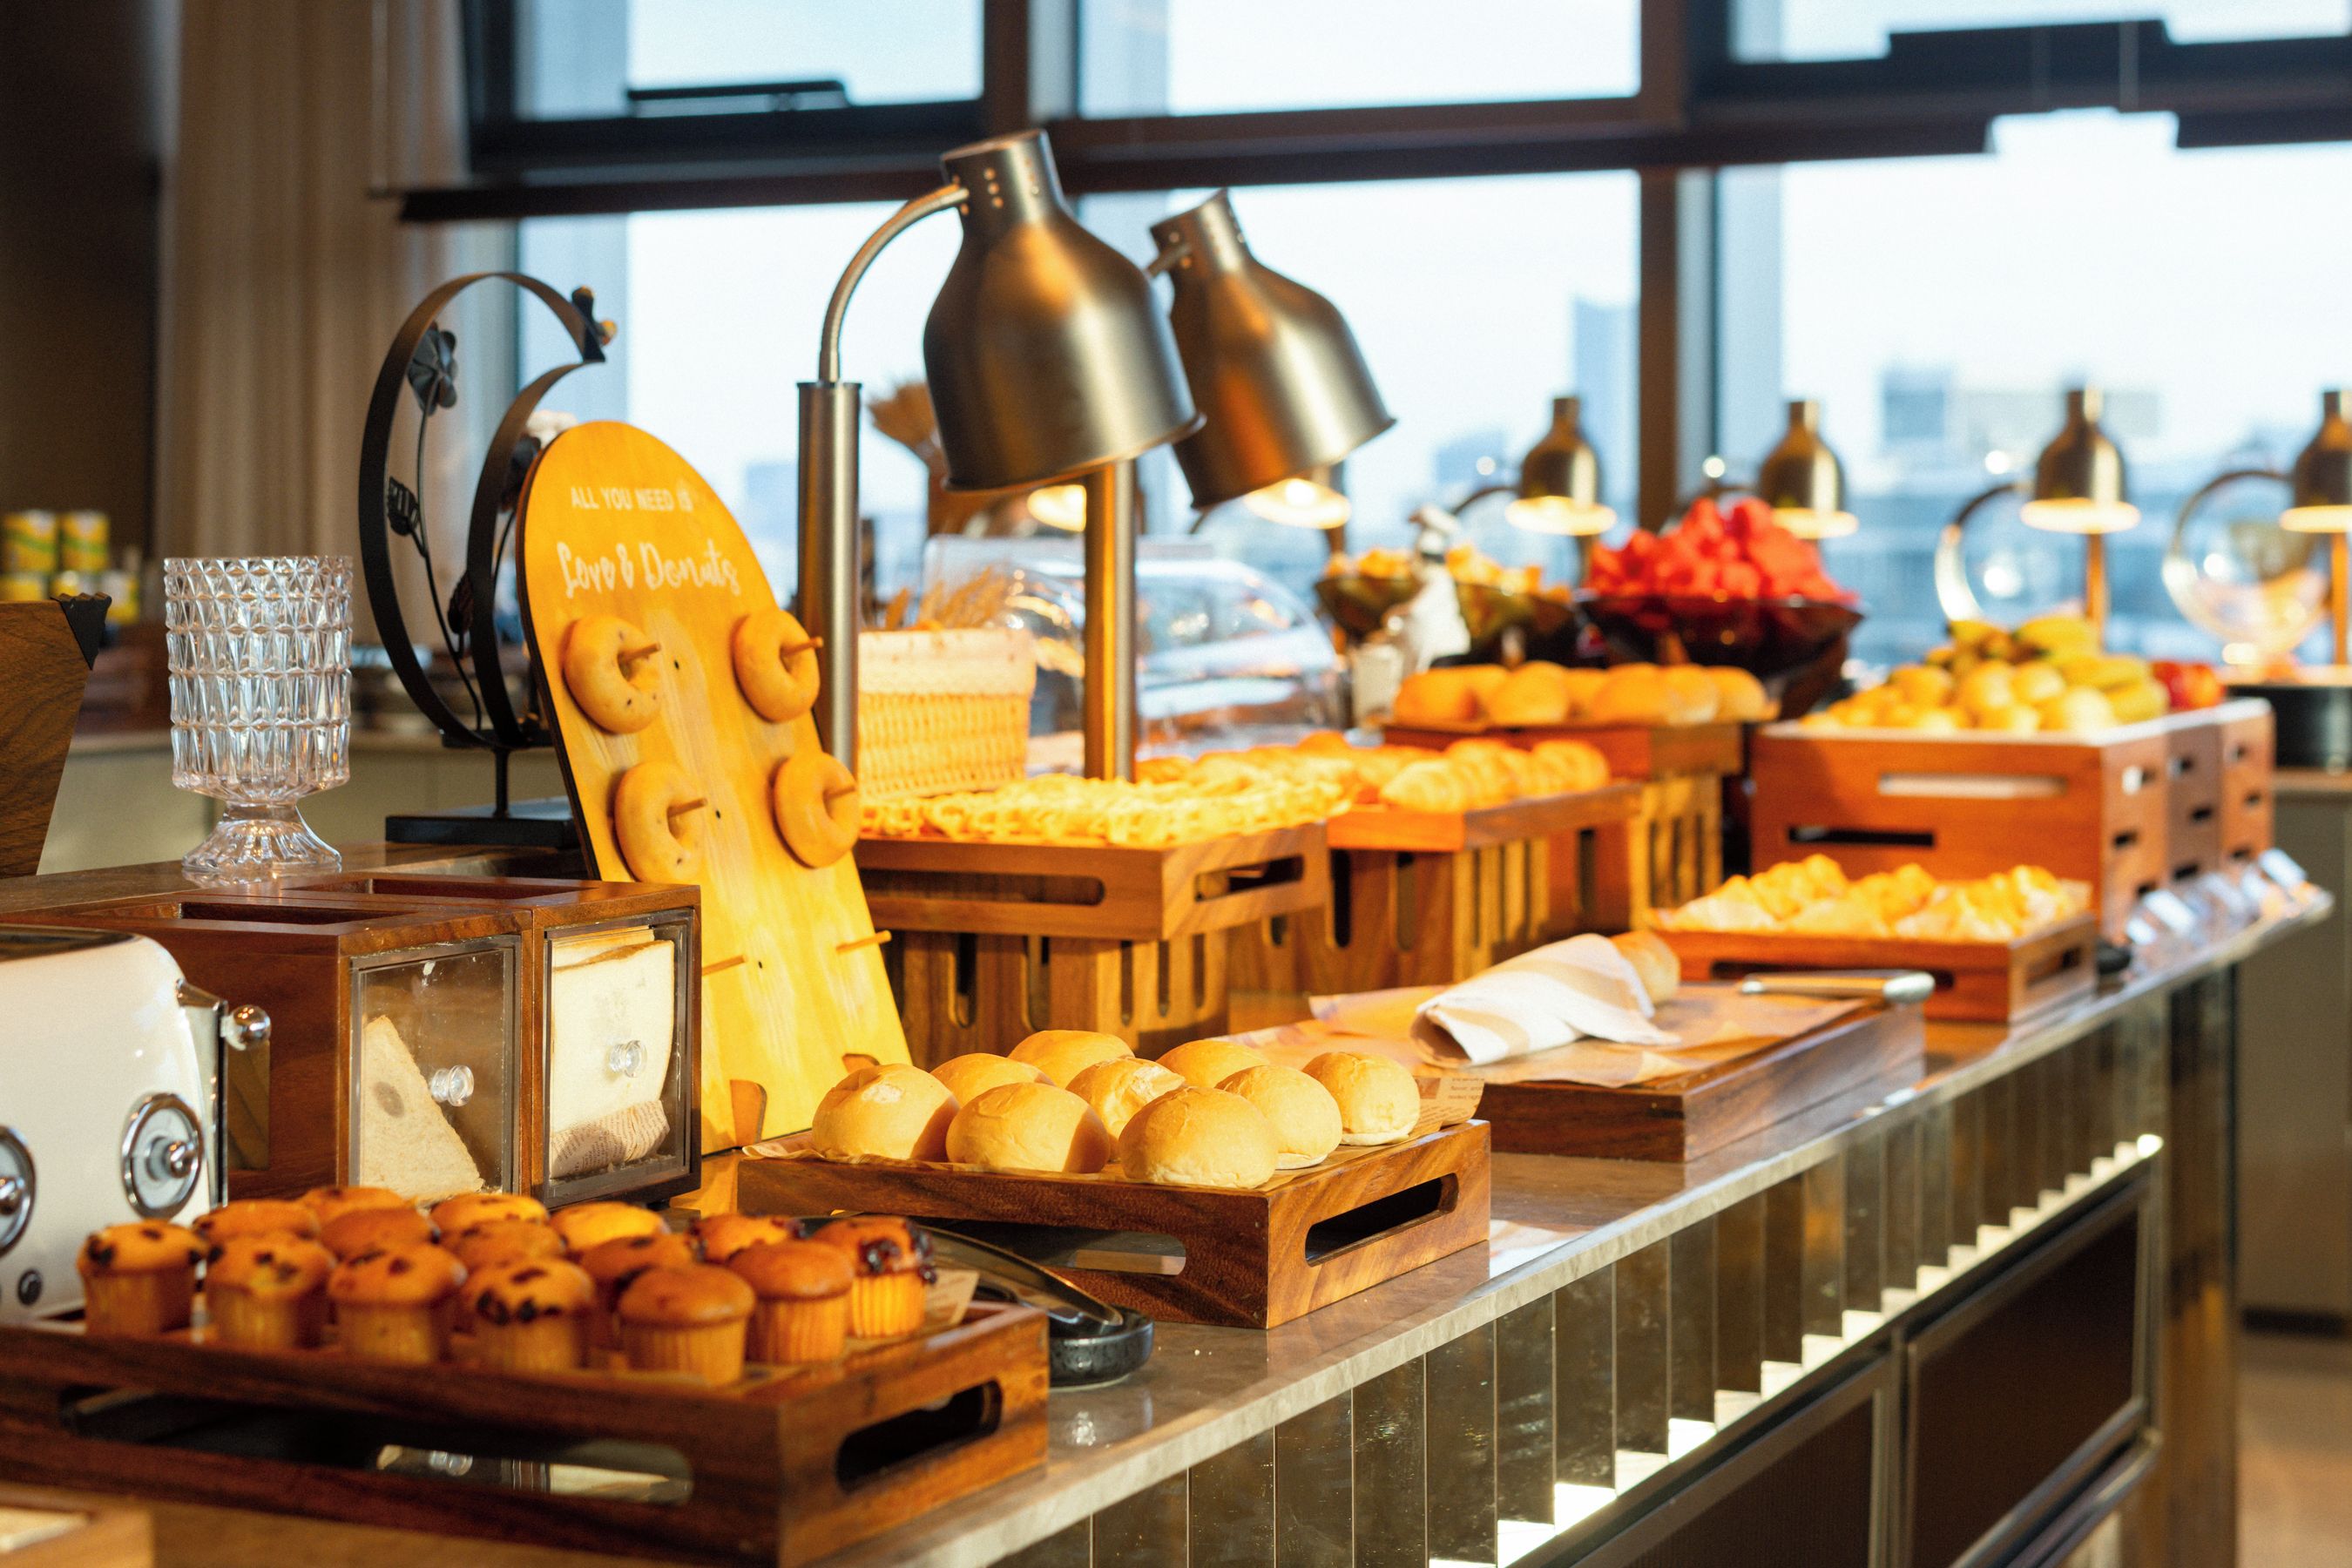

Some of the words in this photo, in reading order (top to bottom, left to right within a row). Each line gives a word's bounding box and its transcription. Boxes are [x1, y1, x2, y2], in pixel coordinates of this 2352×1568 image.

[571, 487, 599, 510] ALL
[601, 487, 632, 510] YOU
[634, 488, 674, 511] NEED
[557, 541, 615, 598] Love
[639, 538, 740, 597] Donuts
